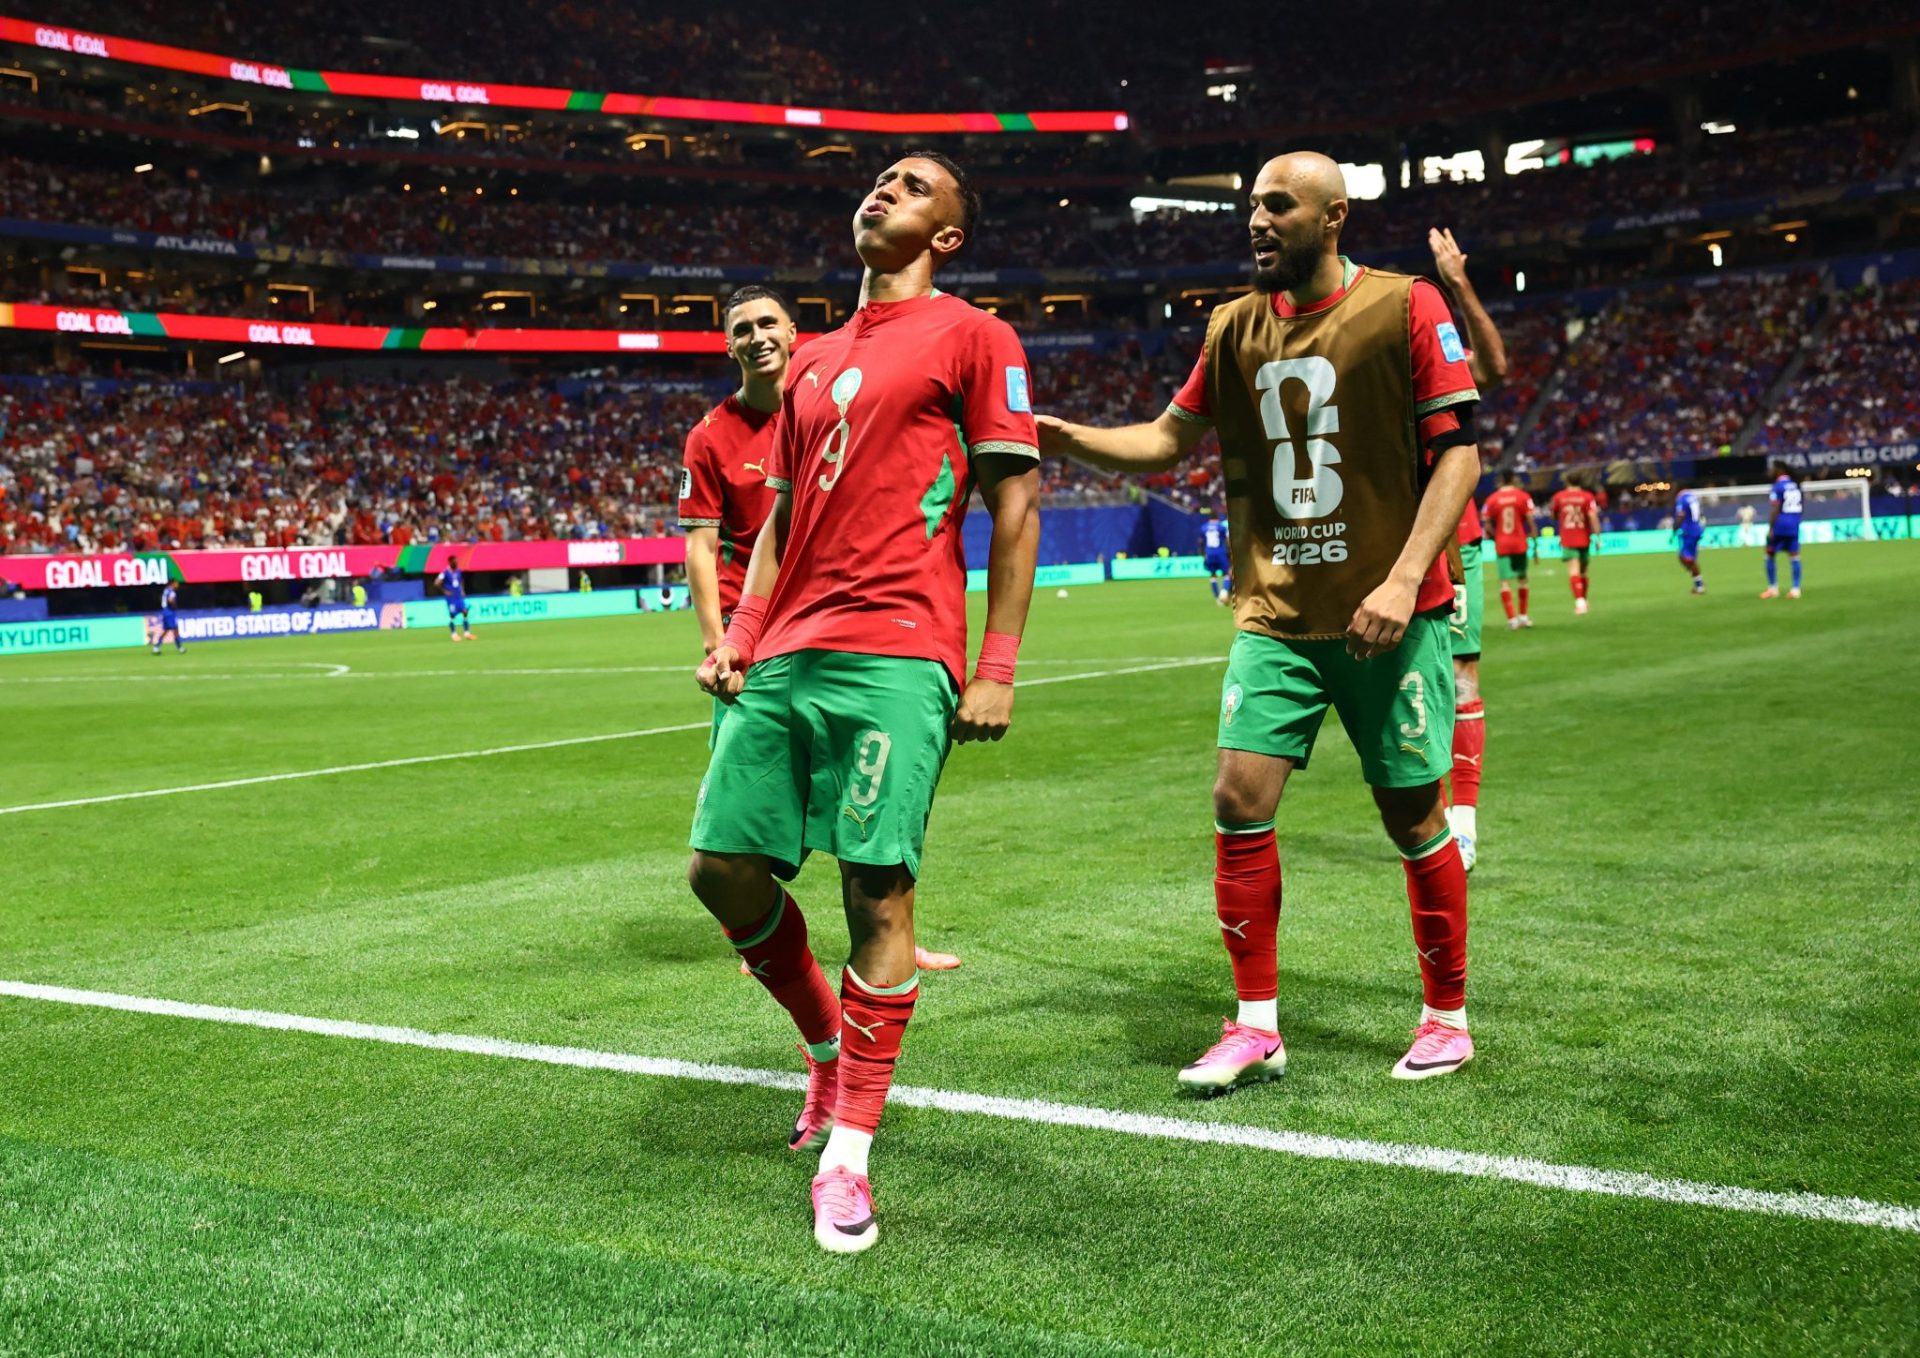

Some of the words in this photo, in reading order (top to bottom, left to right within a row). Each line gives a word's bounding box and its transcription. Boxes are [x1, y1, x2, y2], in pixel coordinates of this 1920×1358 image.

[155, 235, 238, 255] ATLANTA
[650, 265, 724, 279] ATLANTA
[818, 417, 850, 492] 9
[1808, 447, 1877, 467] WORLD
[1879, 444, 1918, 461] CUP
[1292, 487, 1316, 504] FIFA
[1274, 526, 1308, 540] WORLD
[1311, 522, 1346, 538] CUP
[1271, 540, 1348, 565] 2026
[45, 559, 110, 588] GOAL
[241, 554, 296, 580] GOAL
[299, 552, 352, 578] GOAL
[480, 600, 547, 617] HYUNDAI
[177, 616, 235, 638] UNITED
[236, 613, 290, 635] STATES
[291, 611, 312, 632] OF
[312, 608, 377, 631] AMERICA
[0, 626, 89, 647] YUNDAI
[1399, 671, 1428, 738] 3
[851, 730, 892, 806] 9
